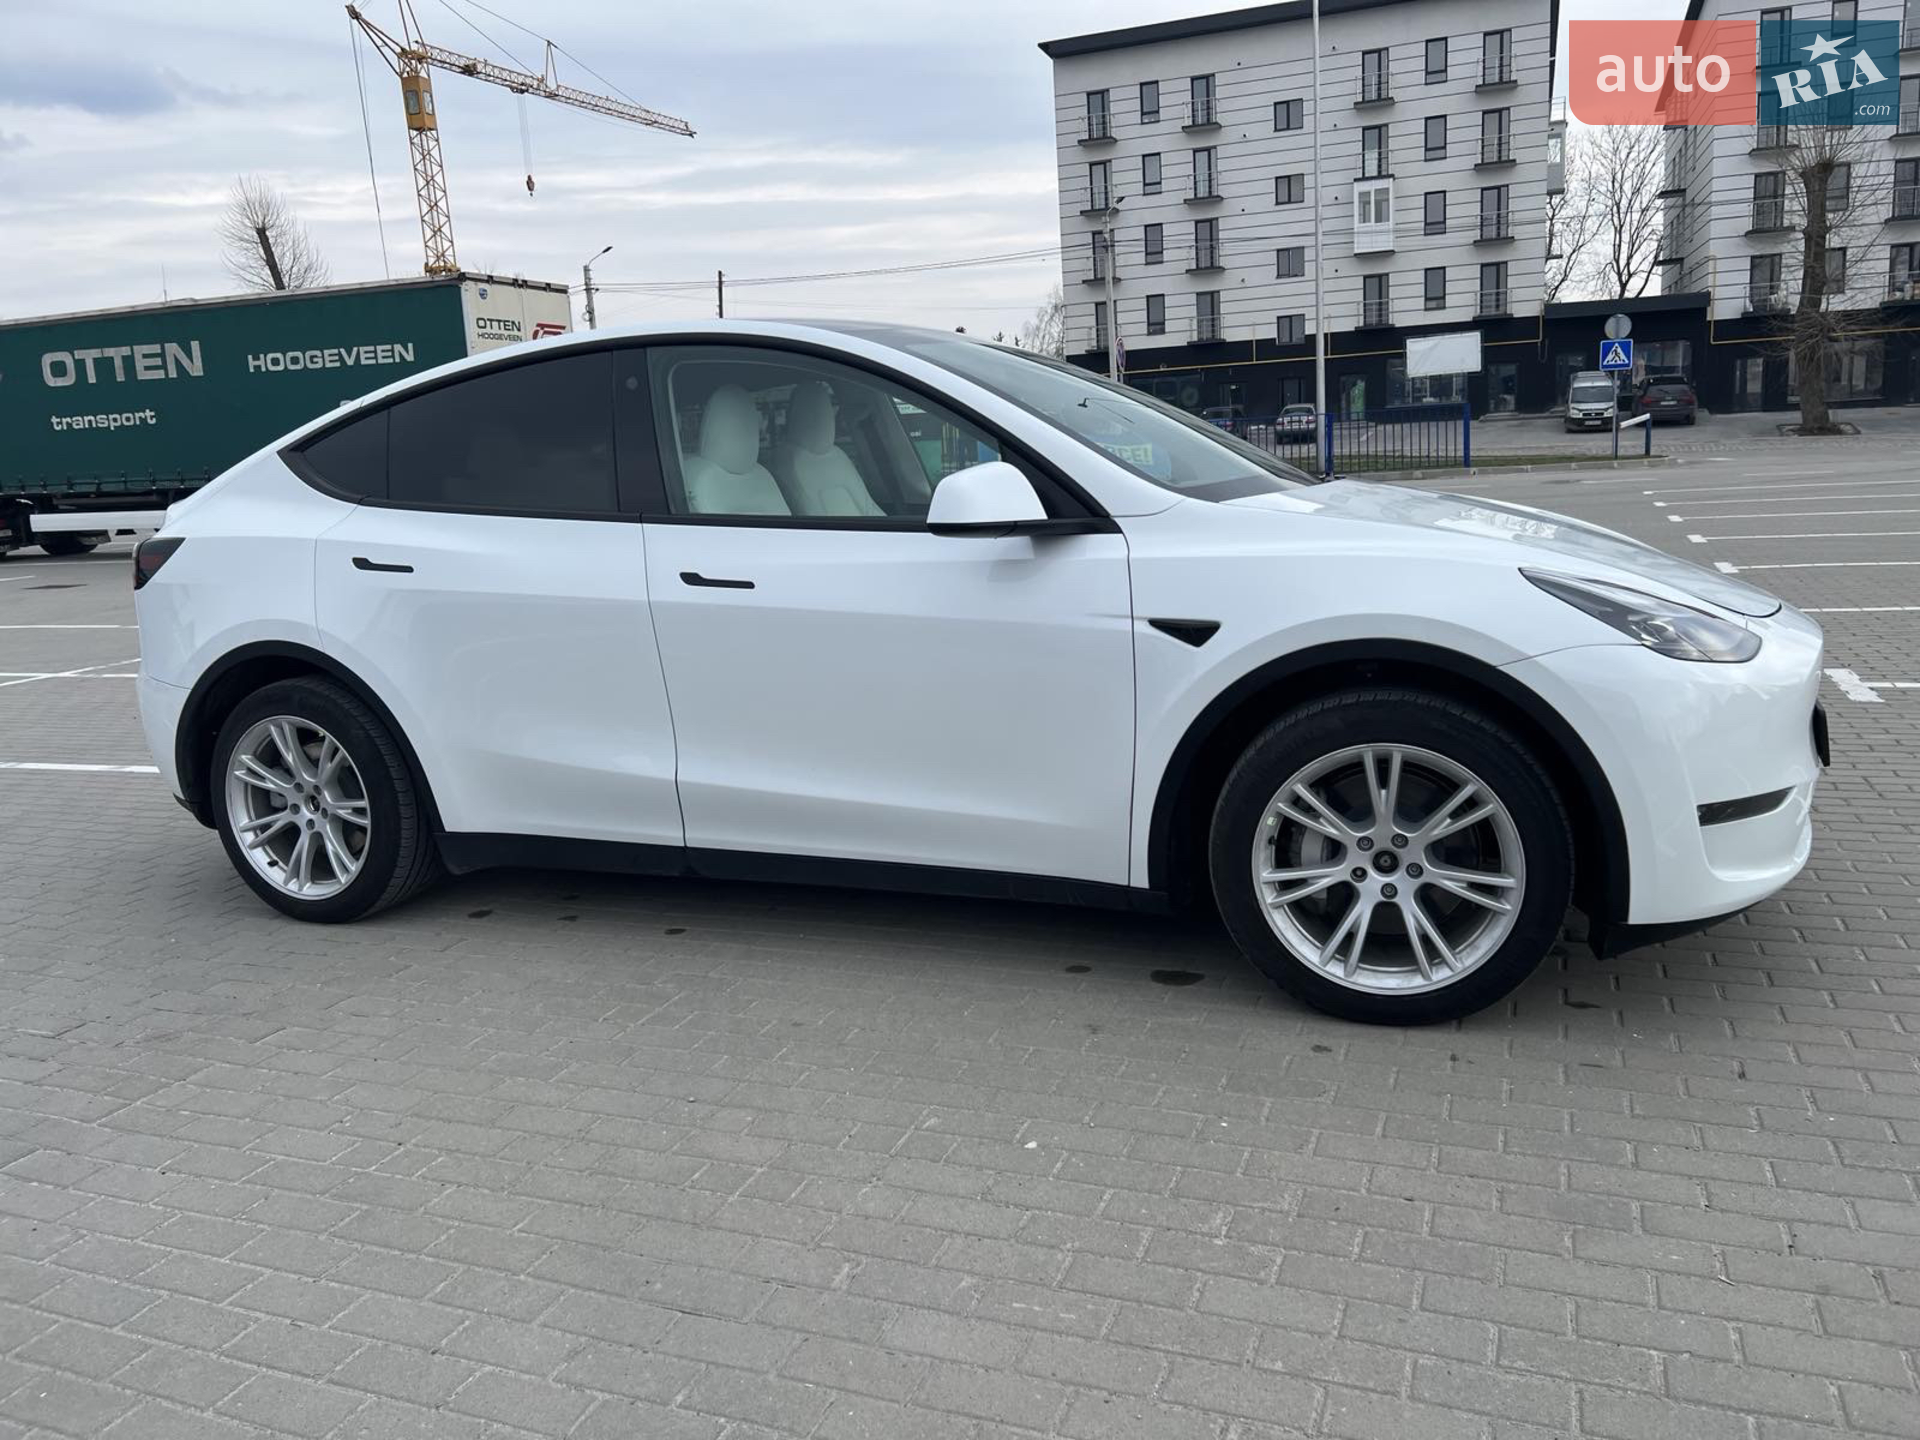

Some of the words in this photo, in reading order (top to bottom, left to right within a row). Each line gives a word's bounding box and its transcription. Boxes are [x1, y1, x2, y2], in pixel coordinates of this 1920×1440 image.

[476, 317, 522, 332] OTTEN
[477, 331, 523, 342] HOOGEVEEN
[41, 340, 205, 387] OTTEN
[247, 342, 415, 373] HOOGEVEEN
[51, 408, 157, 431] transport
